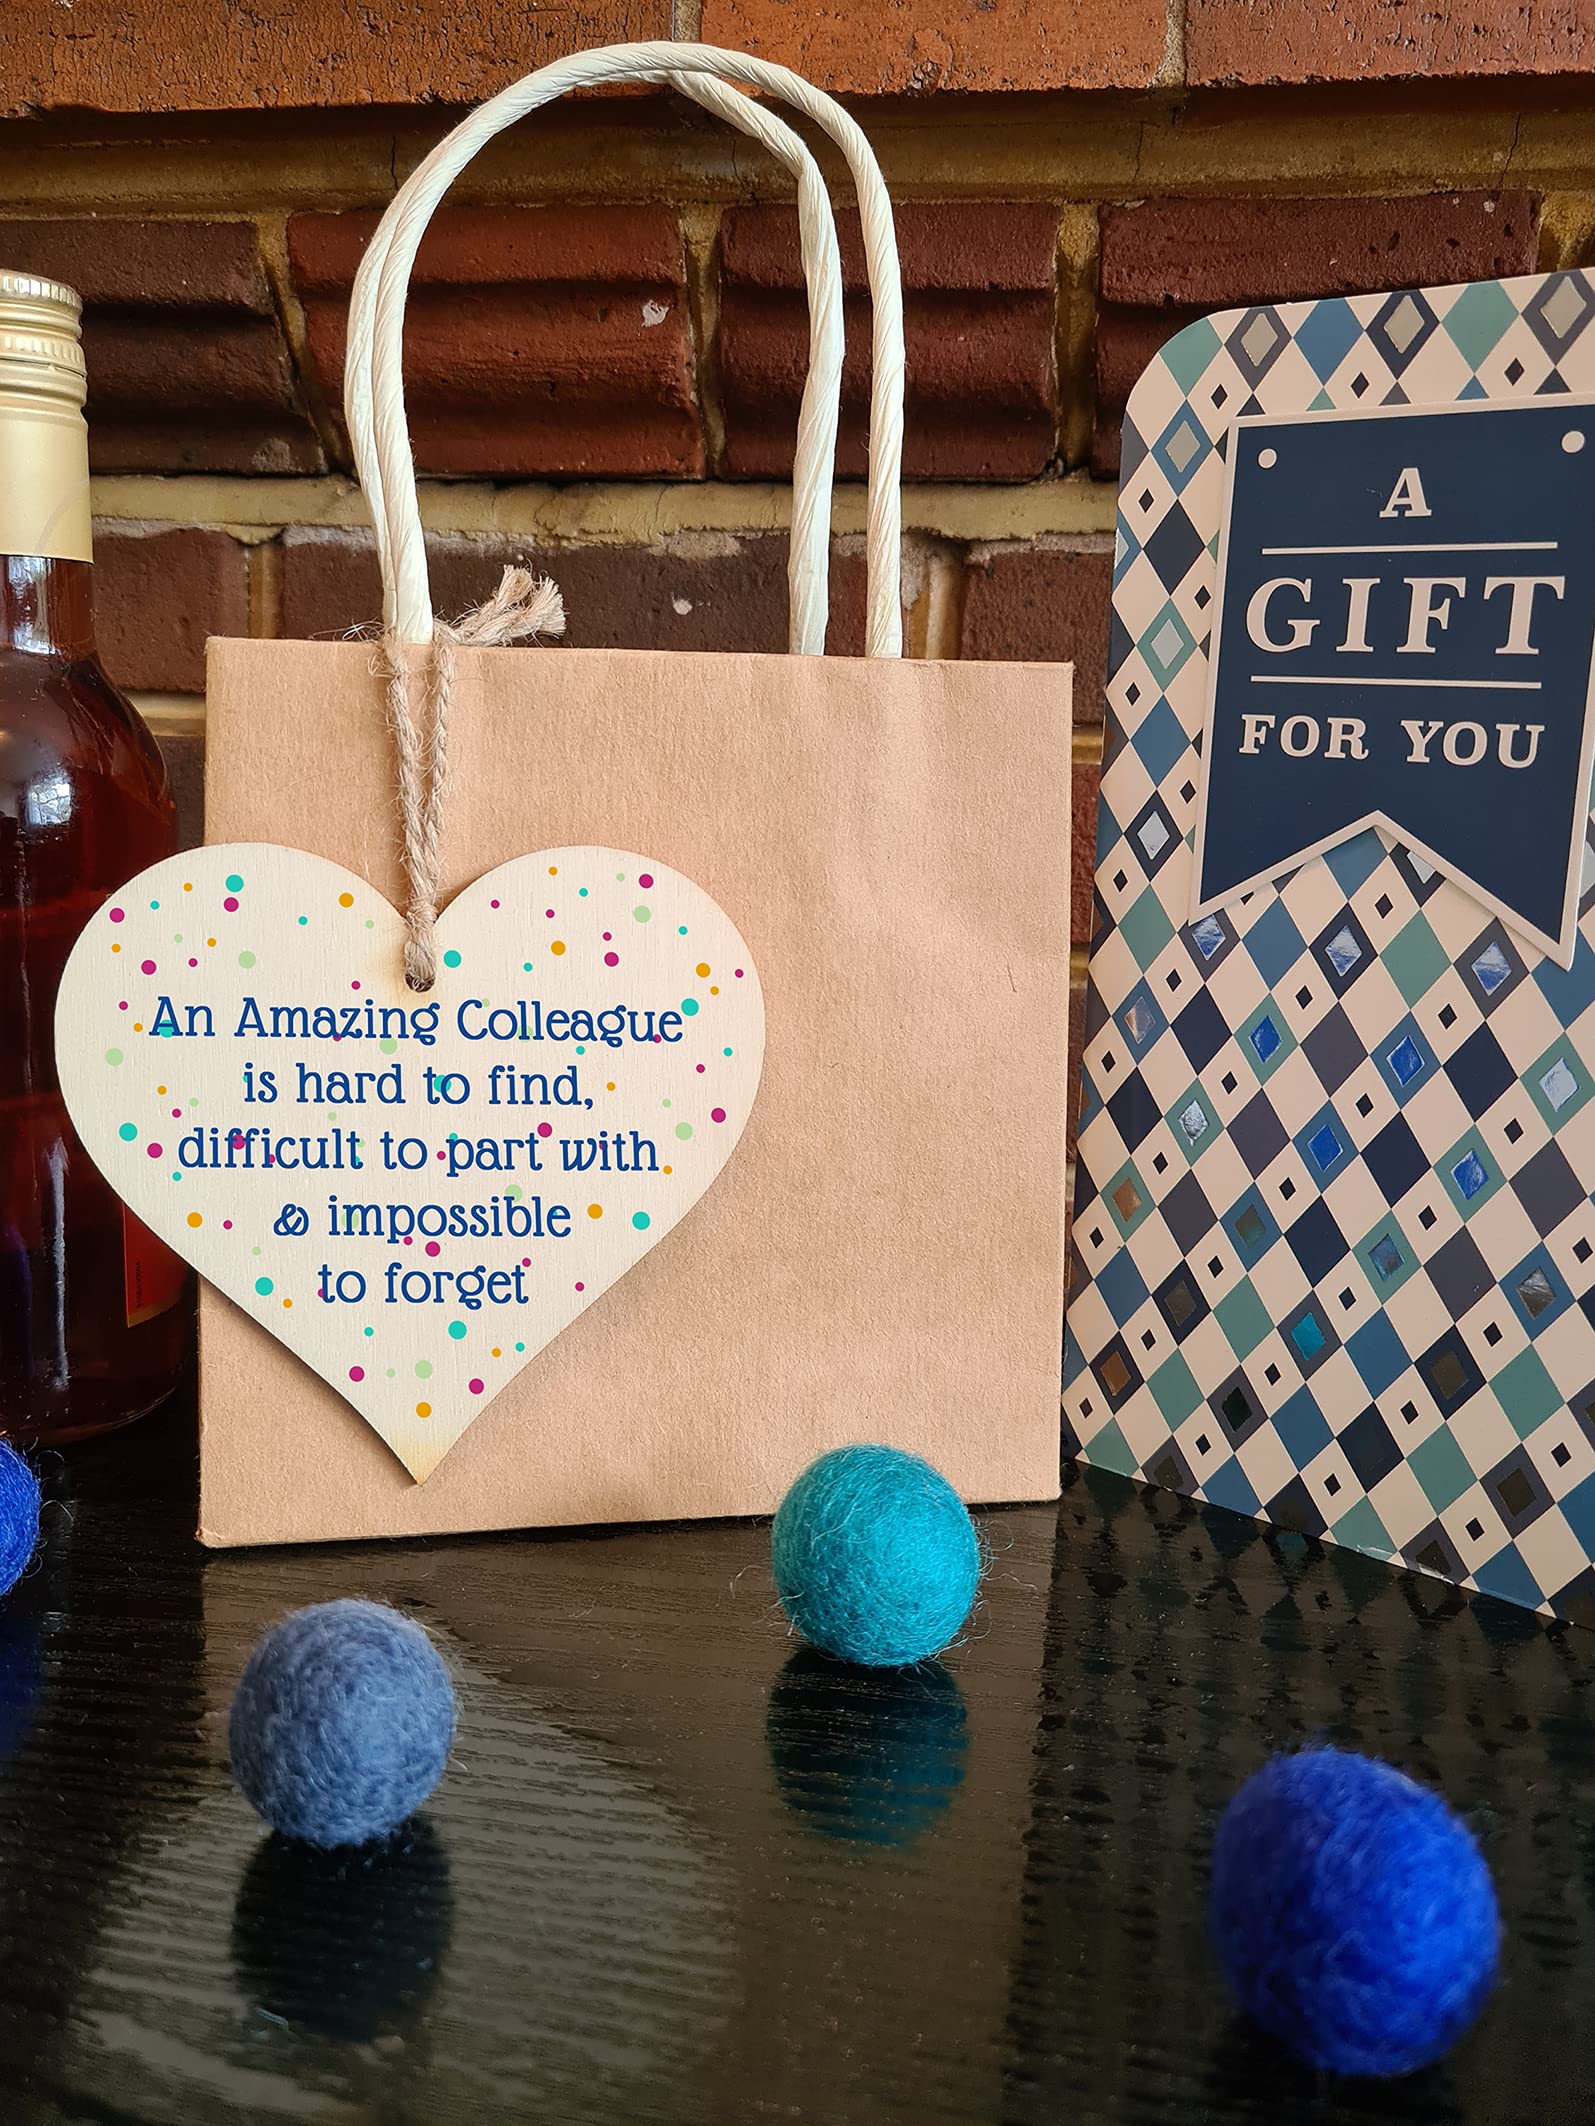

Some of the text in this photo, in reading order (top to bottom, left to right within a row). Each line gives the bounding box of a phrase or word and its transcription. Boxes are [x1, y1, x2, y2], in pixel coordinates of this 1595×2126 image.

[1380, 468, 1432, 518] A
[1246, 576, 1566, 655] GIFT
[1239, 714, 1545, 769] FOR YOU
[149, 997, 683, 1048] An Amazing Colleague
[245, 1063, 593, 1110] is hard to find,
[178, 1127, 660, 1178] difficult to part with
[273, 1195, 571, 1244] & impossible
[319, 1262, 529, 1311] to forget
